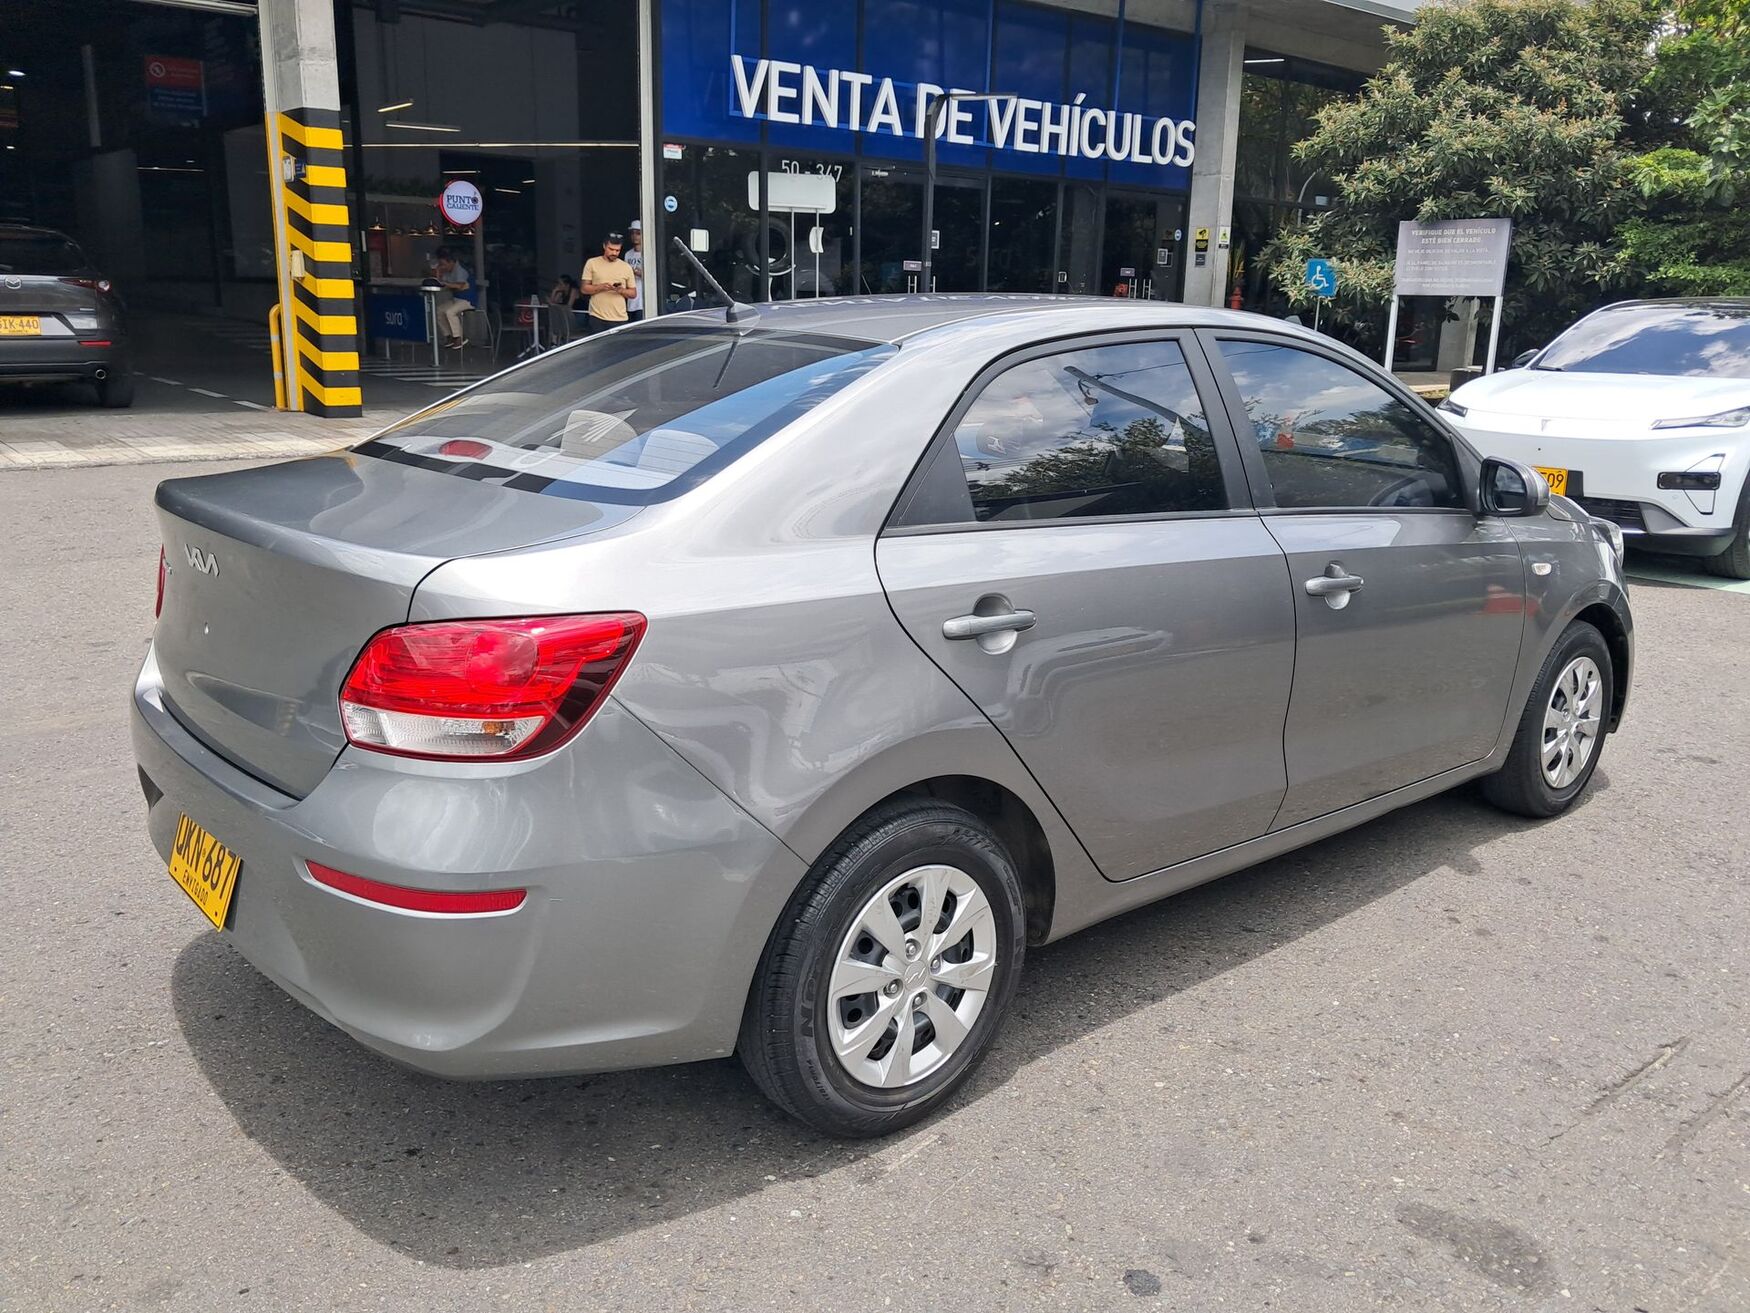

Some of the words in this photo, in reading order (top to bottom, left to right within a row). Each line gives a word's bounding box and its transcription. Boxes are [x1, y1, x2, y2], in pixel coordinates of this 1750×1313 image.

[731, 54, 903, 136] VENTA
[914, 82, 977, 145] DE
[988, 93, 1197, 167] VEHÍCULOS
[781, 160, 800, 175] 50
[816, 163, 843, 182] 347
[446, 194, 479, 205] PUNTO
[446, 202, 480, 211] CALIENTE
[1411, 229, 1442, 237] VERIFIQUE
[1443, 229, 1456, 237] QUE
[1465, 226, 1497, 235] VEHÍCULO
[1452, 236, 1481, 244] CERRADO
[0, 319, 16, 330] IK
[1540, 470, 1564, 489] 09
